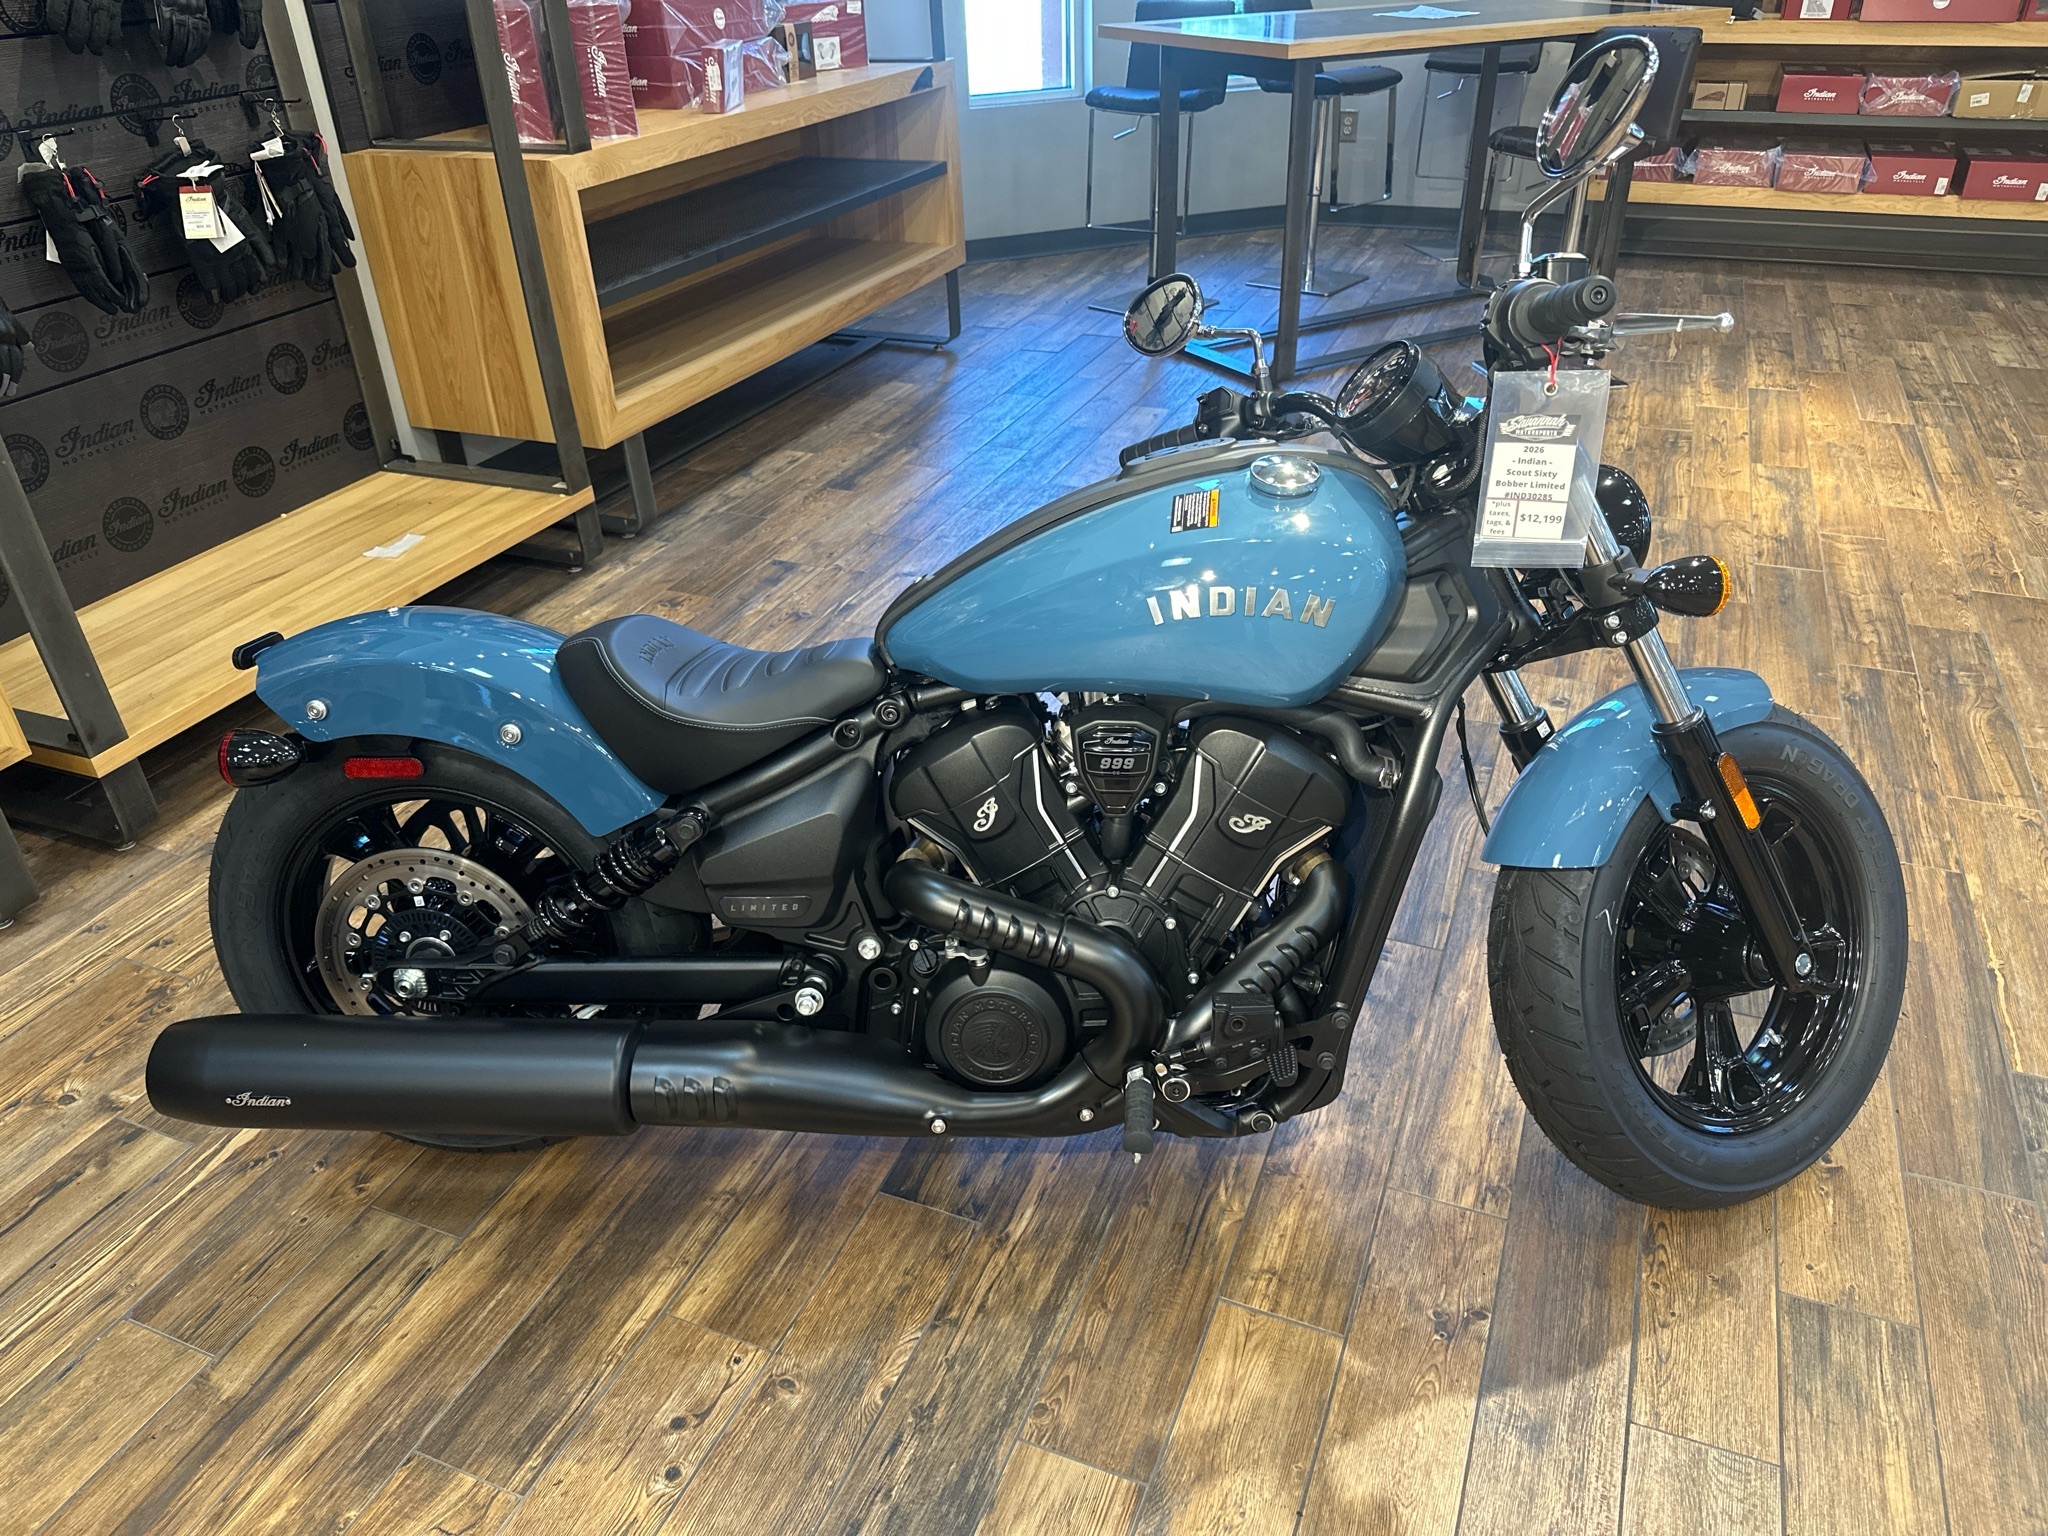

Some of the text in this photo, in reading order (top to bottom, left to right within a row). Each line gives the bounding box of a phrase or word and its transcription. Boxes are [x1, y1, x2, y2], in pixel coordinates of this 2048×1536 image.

[503, 52, 521, 105] Indian
[591, 45, 608, 98] Indian
[112, 76, 130, 97] SINCE
[168, 78, 241, 107] Indian
[1803, 88, 1837, 98] Indian
[1891, 90, 1926, 101] Indian
[113, 95, 160, 111] Indian
[17, 99, 105, 128] Indian
[1720, 161, 1751, 172] Indian
[1804, 165, 1835, 177] Indian
[1893, 170, 1927, 180] Indian
[1993, 175, 2028, 185] Indian
[94, 305, 170, 340] Indian
[36, 332, 85, 354] Indian
[100, 321, 174, 348] MOTORCYCLE
[194, 373, 261, 409] Indian
[199, 389, 264, 416] MOTORCYCLE
[1506, 413, 1568, 433] Savannah
[55, 419, 135, 459] Indian
[62, 435, 137, 467] MOTORCYCLE
[279, 433, 339, 467] Indian
[284, 446, 341, 473] MOTORCYCLE
[1523, 445, 1545, 454] 2026
[1517, 457, 1547, 466] Indian
[234, 462, 273, 483] Indian
[1506, 469, 1558, 480] Scout Sixty
[1495, 480, 1566, 490] Bobber Limited
[158, 478, 228, 519] Indian
[1504, 492, 1553, 501] #IND30285
[164, 494, 230, 526] MOTORCYCLE
[1489, 510, 1511, 518] taxes,
[1519, 513, 1563, 525] $12,199
[106, 512, 150, 538] Indian
[1486, 519, 1506, 527] tags,
[1146, 583, 1337, 628] INDIAN
[1104, 737, 1129, 745] Indian
[1100, 757, 1135, 769] 999
[731, 903, 799, 912] LIMITED
[231, 1091, 286, 1107] Indian
